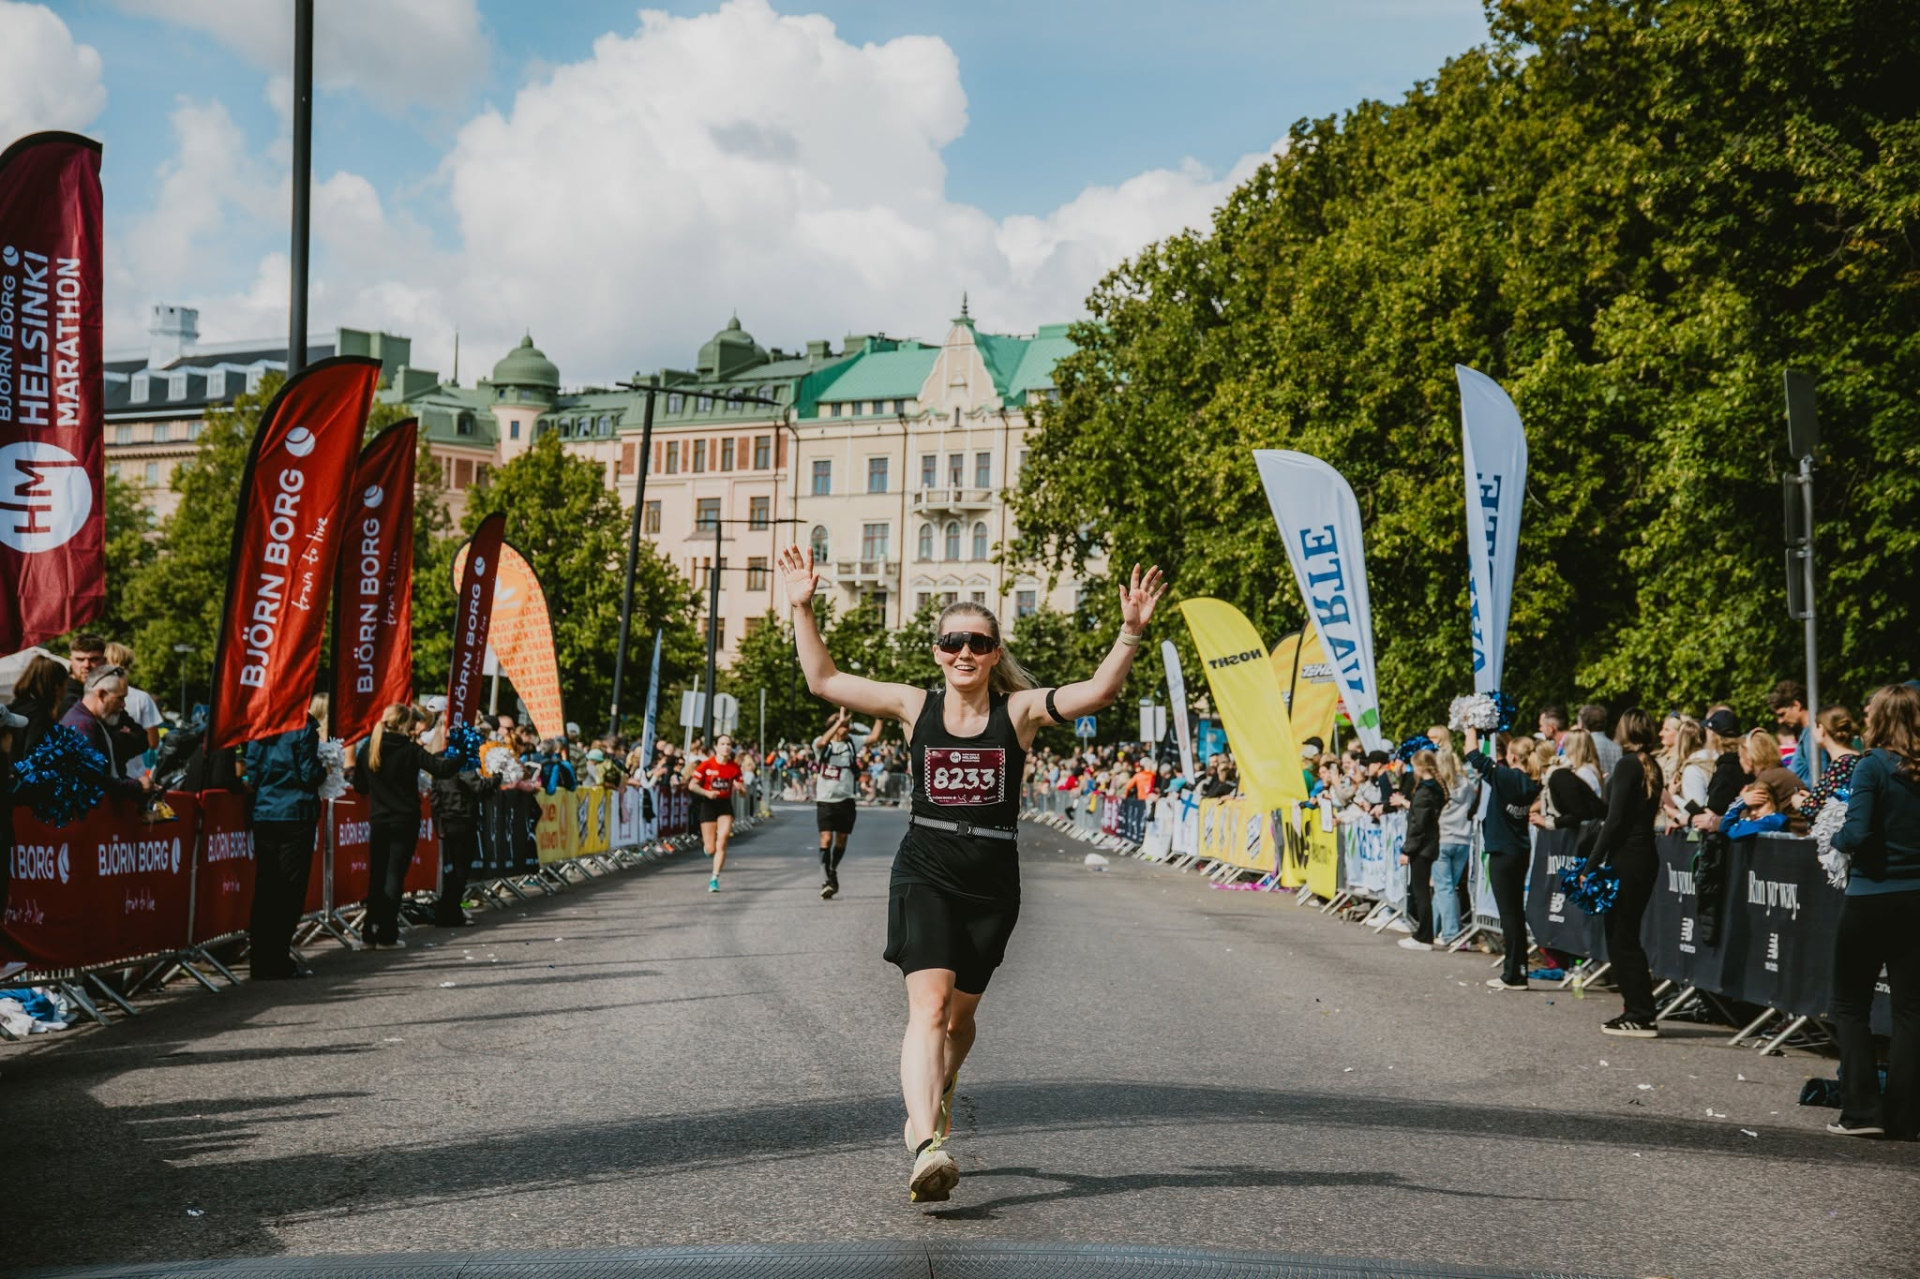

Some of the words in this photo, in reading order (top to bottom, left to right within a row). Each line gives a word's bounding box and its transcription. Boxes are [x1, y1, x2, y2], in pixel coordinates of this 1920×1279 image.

[0, 274, 16, 340] BORG
[18, 250, 49, 426] HELSINKI
[56, 258, 81, 427] MARATHON
[305, 517, 328, 542] live
[302, 548, 319, 565] to
[360, 518, 380, 595] BORG
[239, 573, 286, 689] BJÖRN
[264, 469, 305, 567] BORG
[291, 572, 313, 611] train
[354, 603, 378, 693] BJÖRN
[453, 652, 473, 728] BJÖRN
[465, 583, 481, 647] BORG
[933, 767, 996, 790] 8233
[208, 826, 230, 862] BJÖRN
[230, 831, 247, 859] BORG
[339, 817, 358, 847] BJÖRN
[358, 821, 371, 845] BOR
[17, 844, 55, 880] BORG
[98, 834, 136, 876] BJÖRN
[138, 840, 168, 872] BORG
